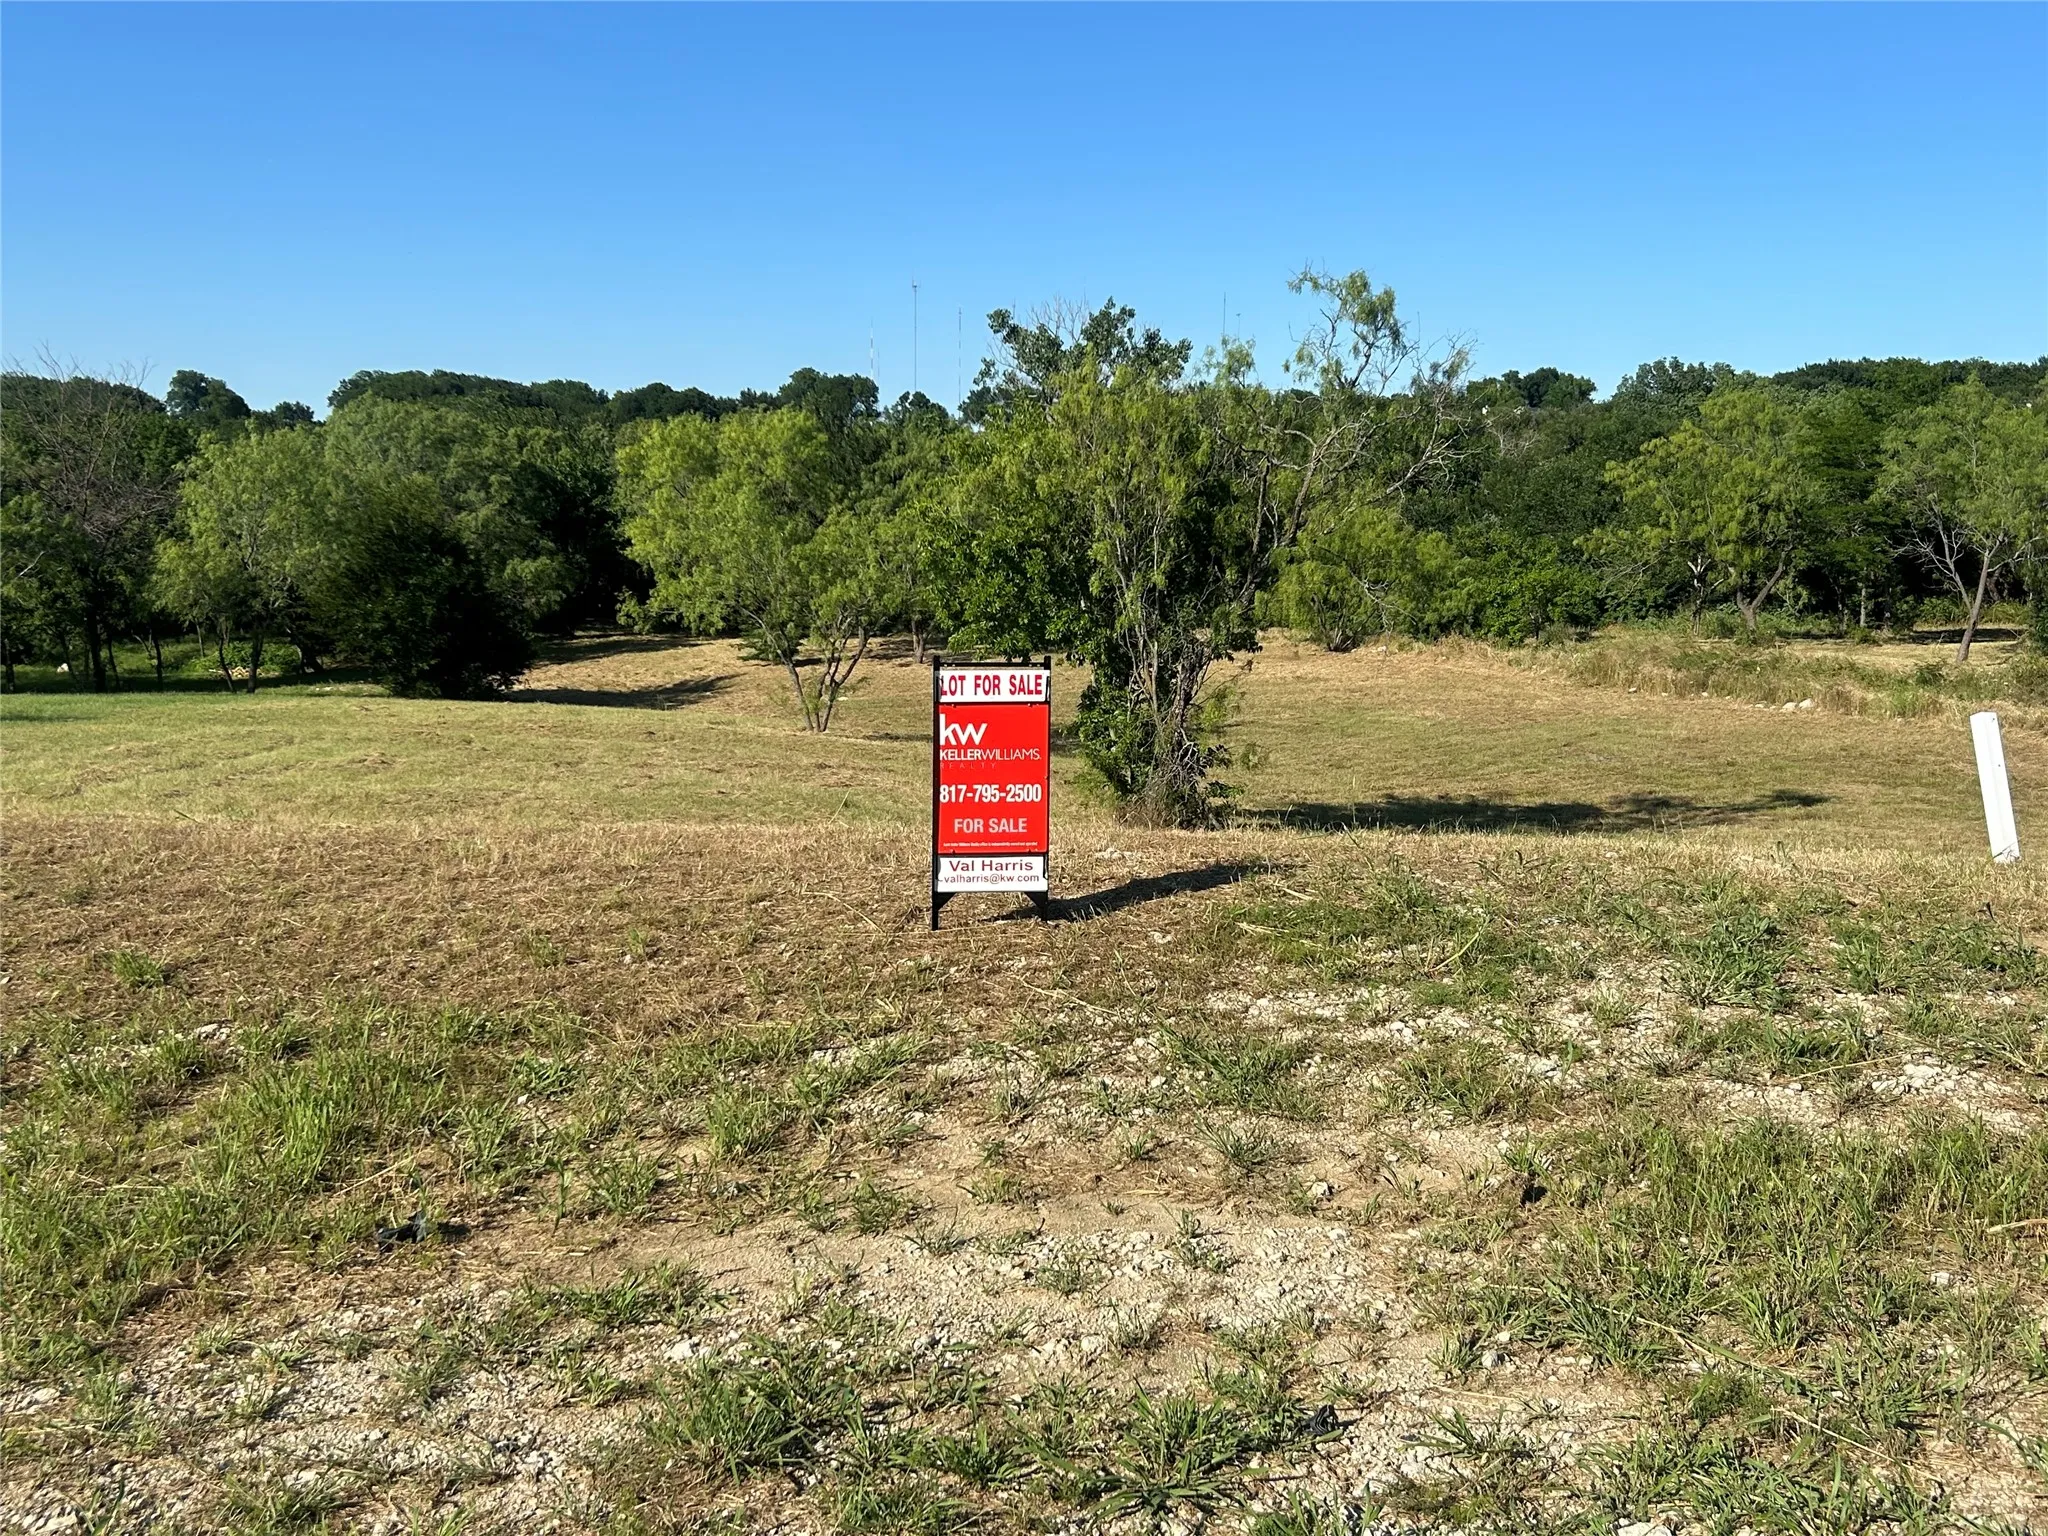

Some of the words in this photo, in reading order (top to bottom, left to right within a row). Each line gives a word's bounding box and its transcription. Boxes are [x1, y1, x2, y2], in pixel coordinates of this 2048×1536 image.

[941, 675, 966, 696] LOT
[974, 675, 1001, 696] FOR
[1009, 674, 1042, 695] SALE
[940, 784, 1042, 803] 817-795-2500
[954, 818, 984, 833] FOR
[989, 818, 1028, 833] SALE
[949, 860, 975, 872] Val
[981, 859, 1034, 872] Harris
